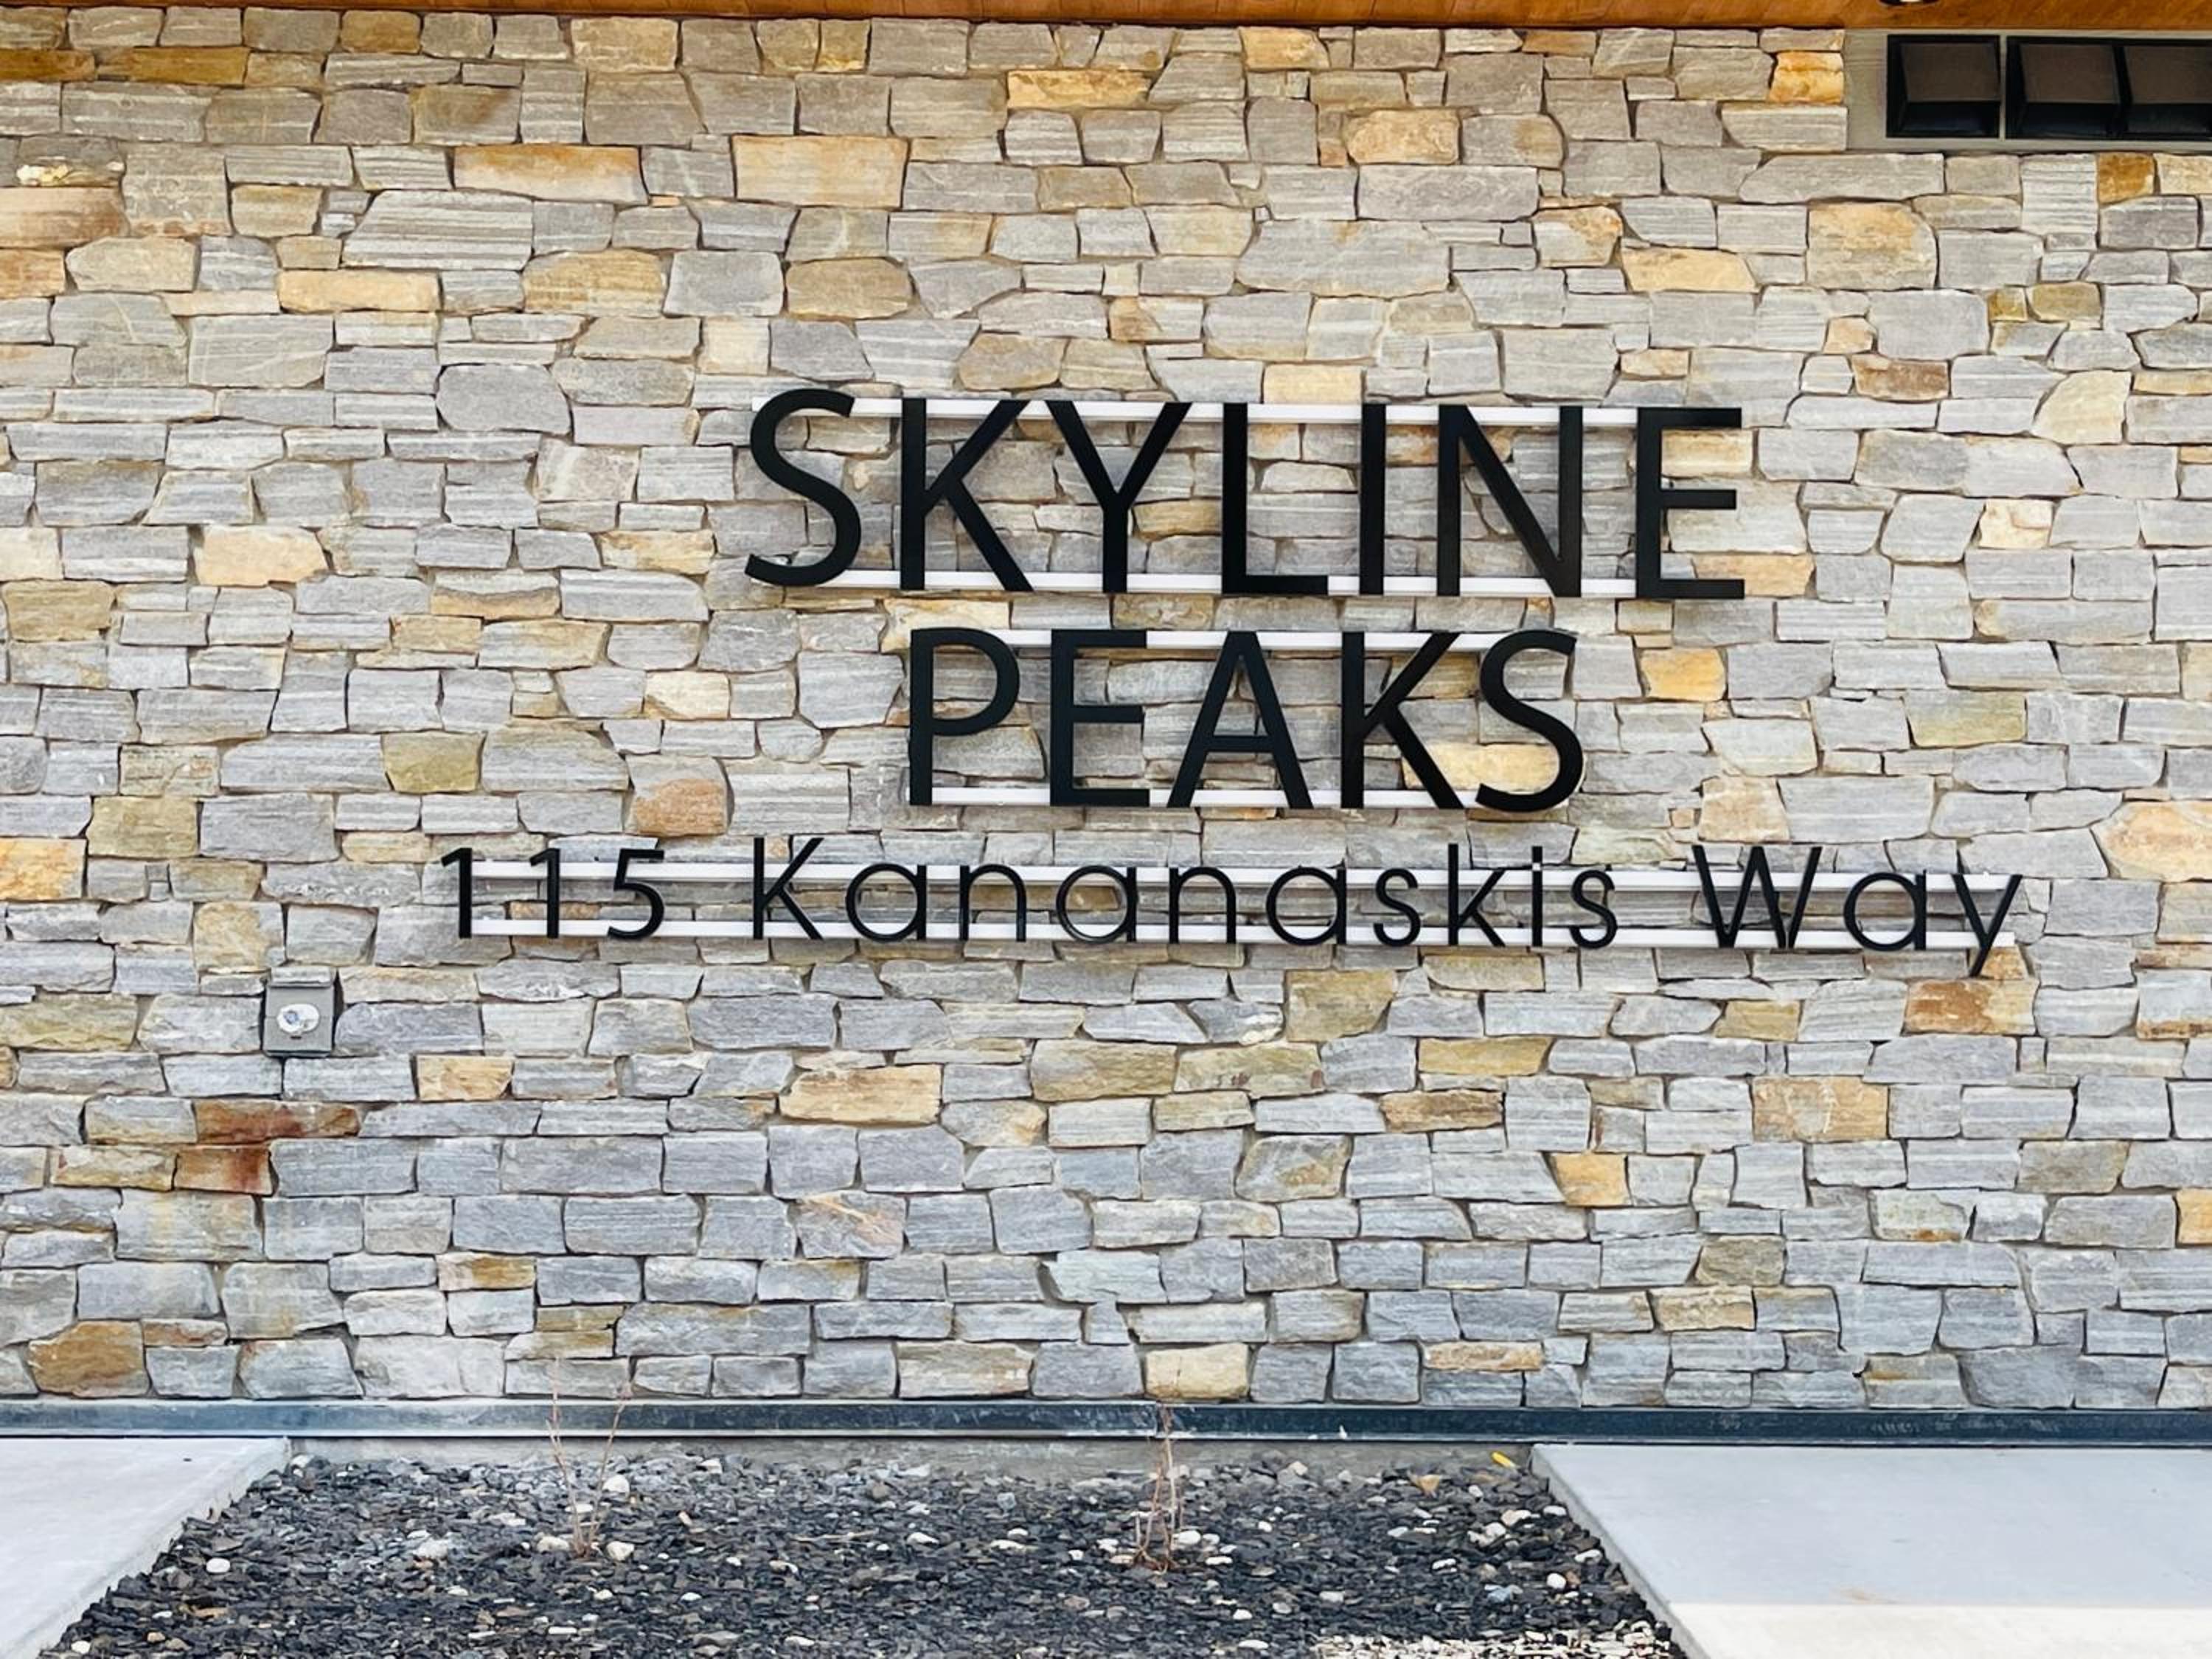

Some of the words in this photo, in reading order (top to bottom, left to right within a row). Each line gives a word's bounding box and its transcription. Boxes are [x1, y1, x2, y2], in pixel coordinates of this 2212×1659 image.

[745, 388, 1745, 598] SKYLINE
[908, 627, 1583, 813] PEAKS
[442, 847, 665, 942] 115
[754, 838, 1618, 950] Kananaskis
[1691, 845, 2023, 978] Way
